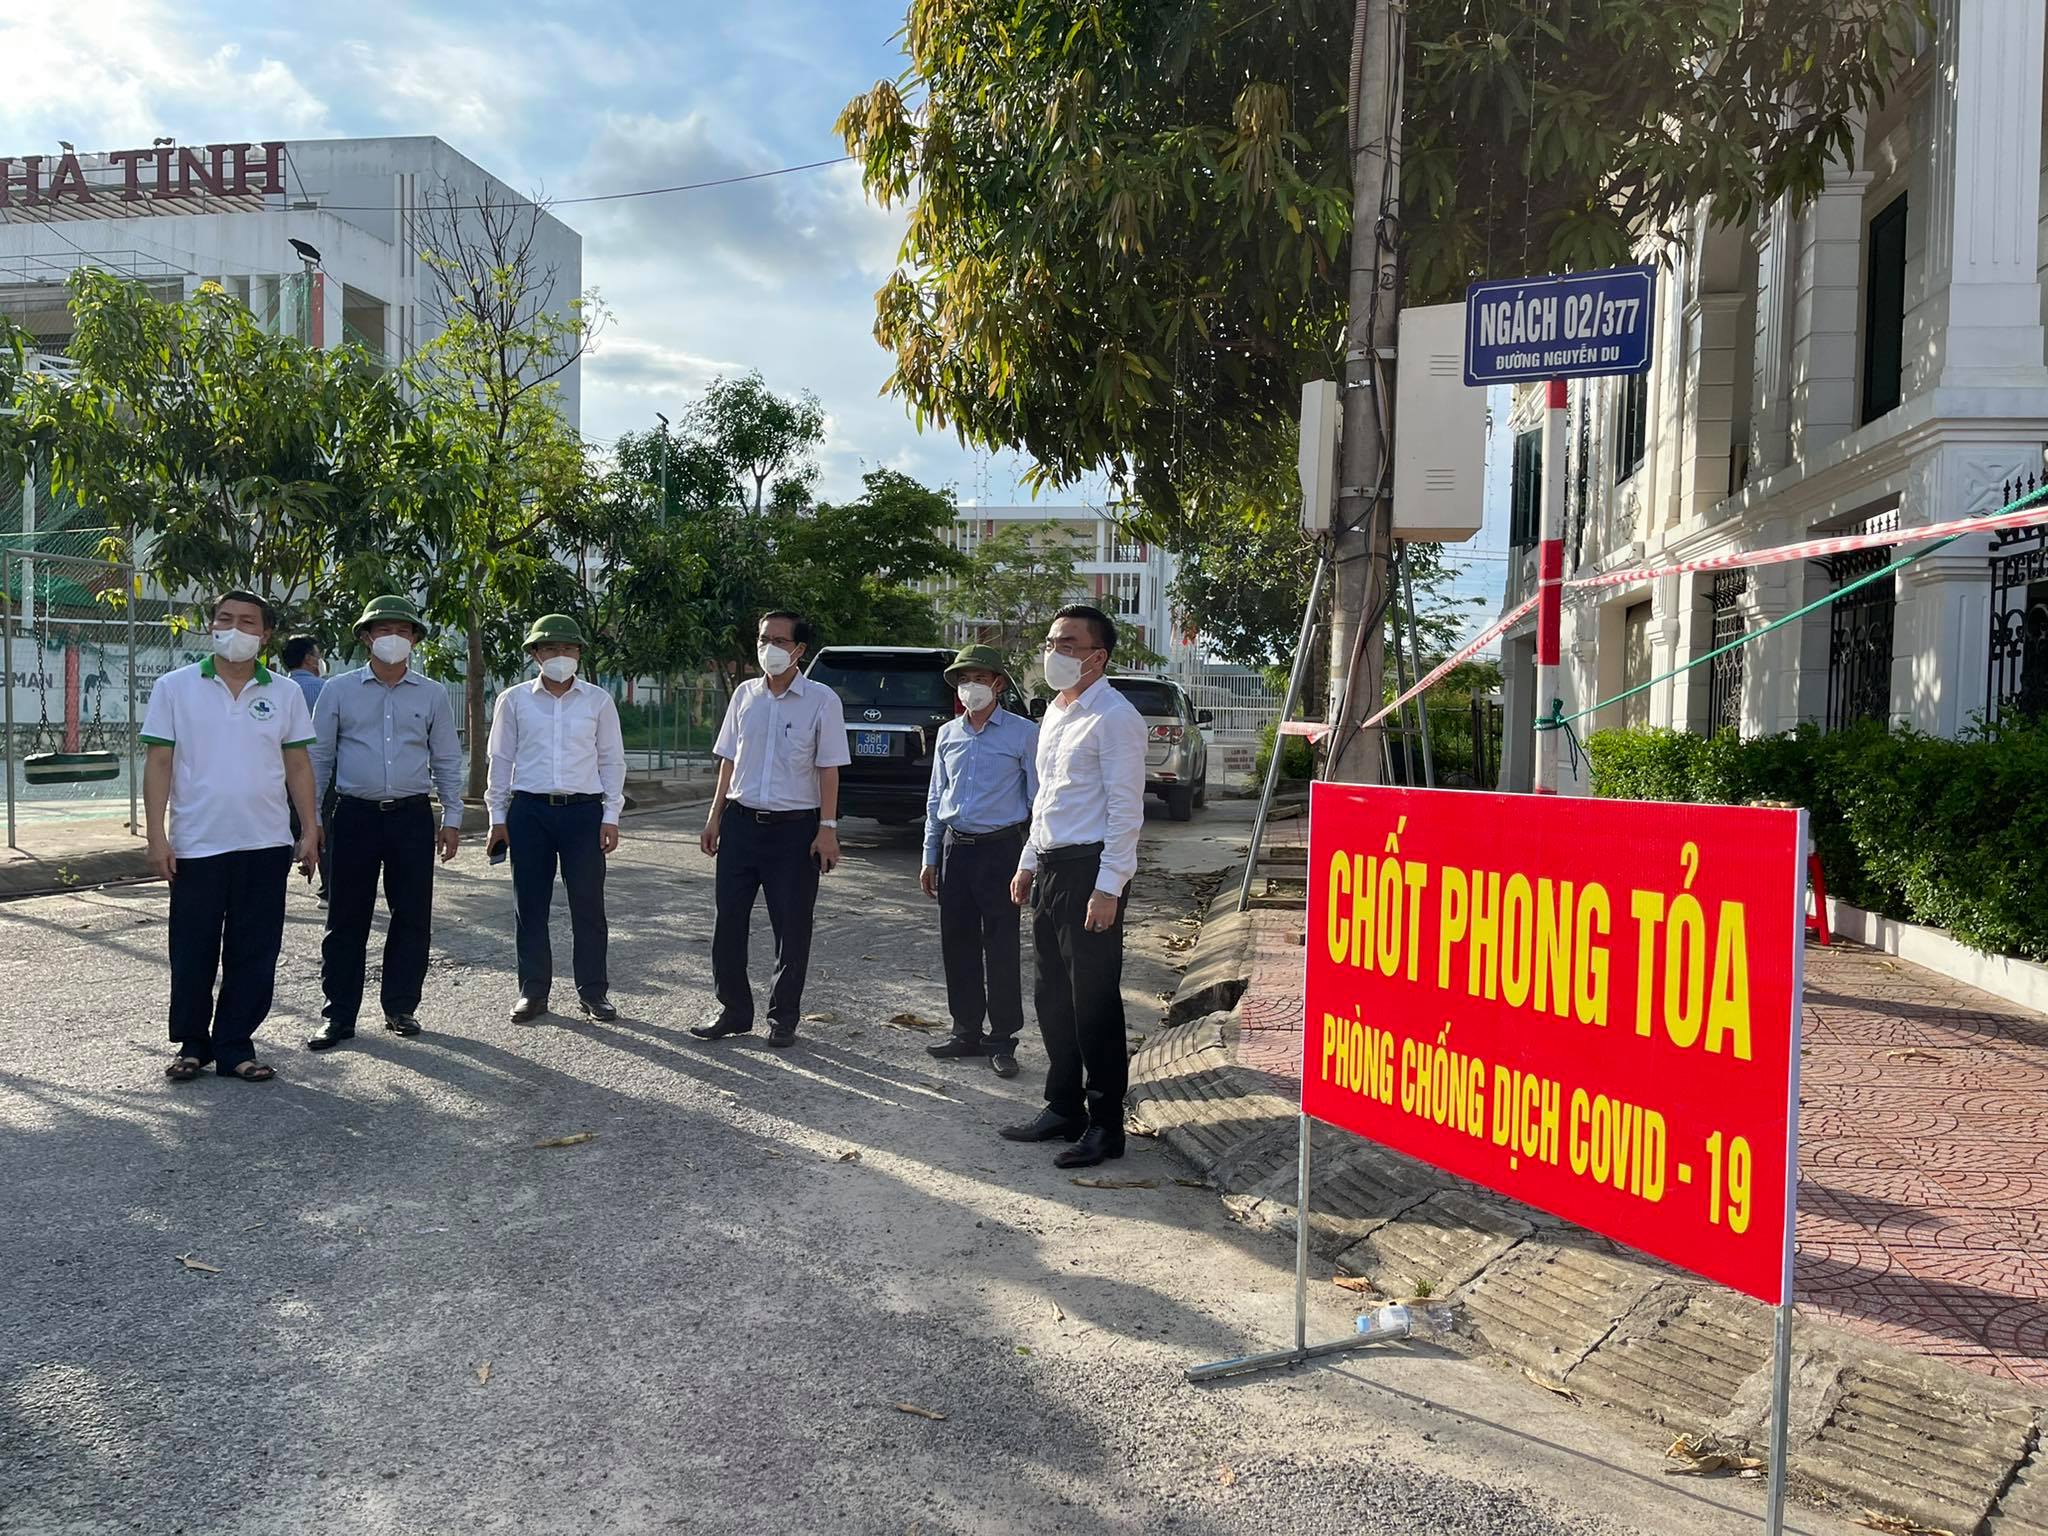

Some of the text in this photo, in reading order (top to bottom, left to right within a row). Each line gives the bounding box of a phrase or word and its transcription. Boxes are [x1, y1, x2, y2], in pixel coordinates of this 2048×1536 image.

[0, 137, 286, 207] HÀ TĨNH
[1480, 290, 1640, 347] NGÁCH 02/377
[1496, 344, 1620, 370] ĐƯỜNG NGUYỄN DU
[857, 743, 888, 754] 000.52
[1327, 815, 1752, 1061] CHỐT PHONG TỎA
[1322, 1004, 1394, 1105] PHÒNG
[1401, 1021, 1485, 1138] CHỐNG
[1492, 1064, 1561, 1170] DỊCH
[1569, 1087, 1666, 1202] COVID
[1706, 1130, 1752, 1234] 19
